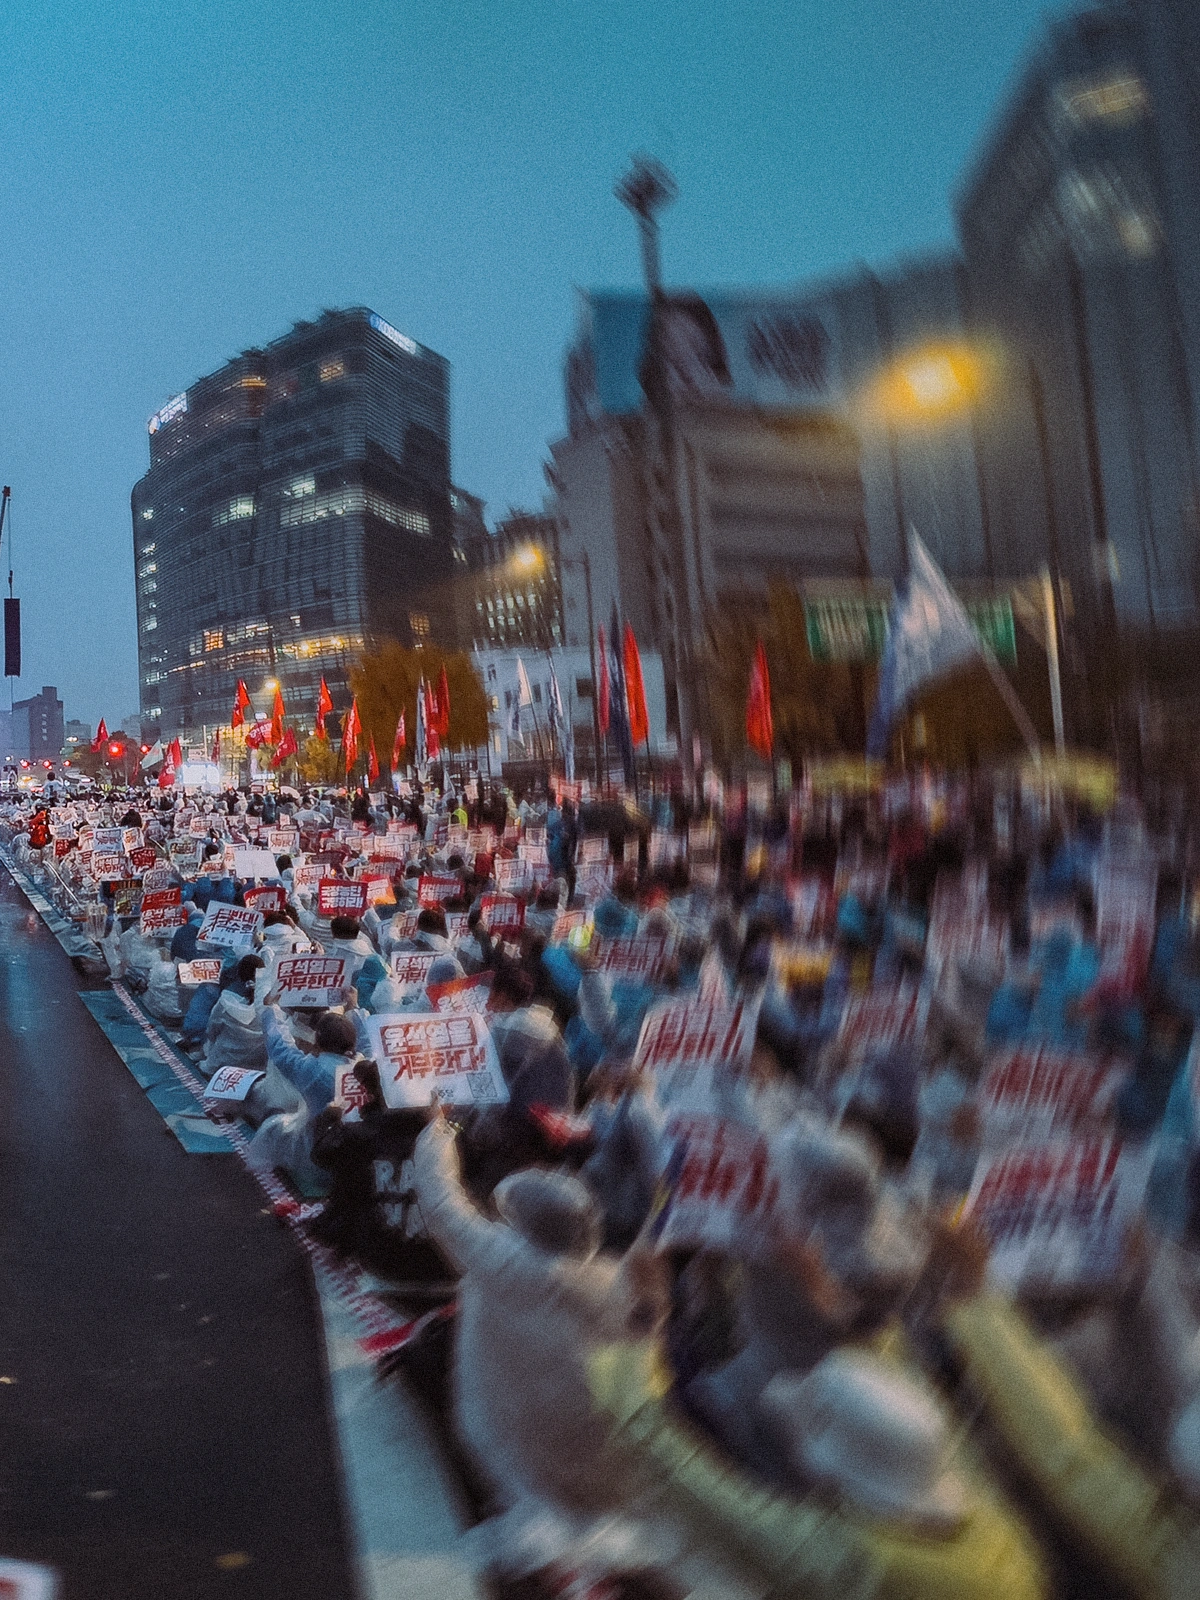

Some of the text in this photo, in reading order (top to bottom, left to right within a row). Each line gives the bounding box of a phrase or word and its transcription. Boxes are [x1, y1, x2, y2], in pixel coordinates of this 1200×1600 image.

[278, 958, 345, 979] 윤석열을
[278, 974, 345, 992] 거부한다!
[380, 1017, 477, 1057] 윤석열을
[391, 1046, 486, 1081] 거부한다!
